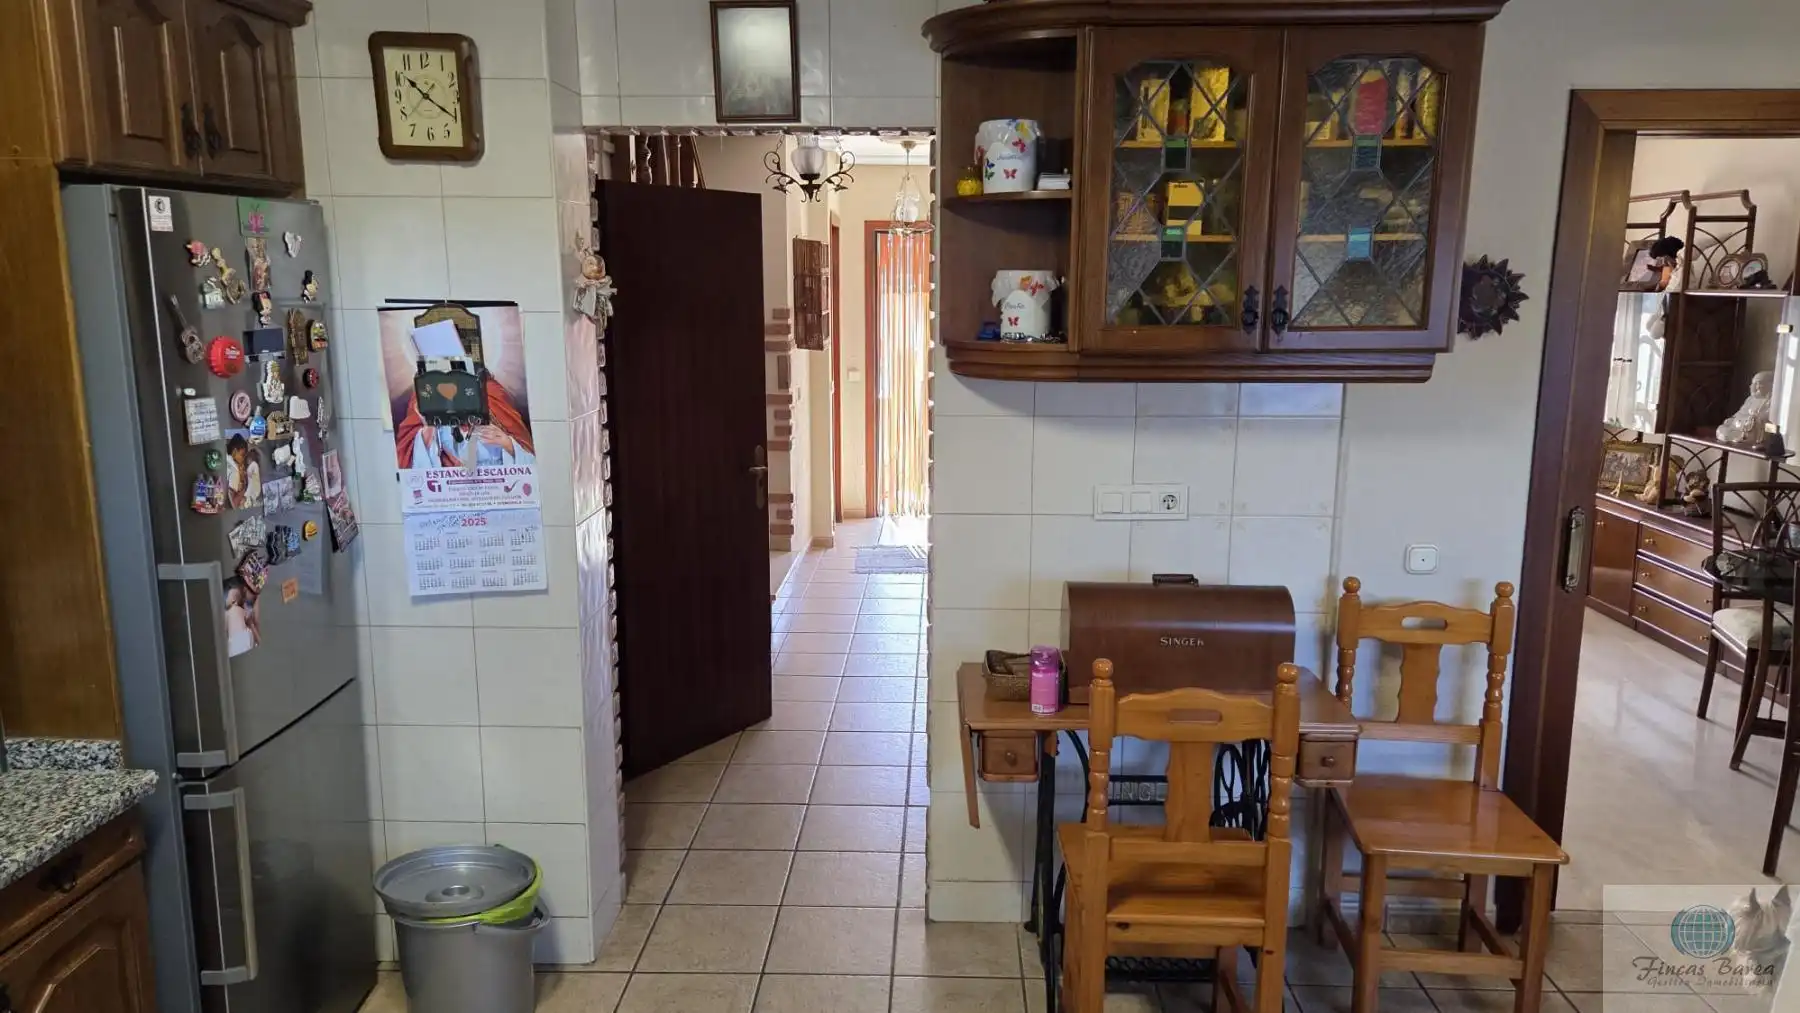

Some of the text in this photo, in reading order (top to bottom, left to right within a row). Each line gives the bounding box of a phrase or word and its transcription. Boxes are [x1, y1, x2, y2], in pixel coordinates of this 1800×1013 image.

[402, 53, 411, 71] 11
[419, 51, 430, 70] 12
[440, 54, 444, 72] 1
[394, 70, 405, 87] 10
[447, 72, 456, 88] 2
[394, 89, 402, 104] 9
[452, 90, 461, 104] 3
[400, 106, 408, 122] 8
[408, 123, 416, 138] 7
[427, 126, 435, 141] 6
[443, 122, 451, 139] 5
[476, 467, 532, 477] ESCALONA
[461, 517, 487, 527] 2025
[1159, 636, 1205, 646] SINGER
